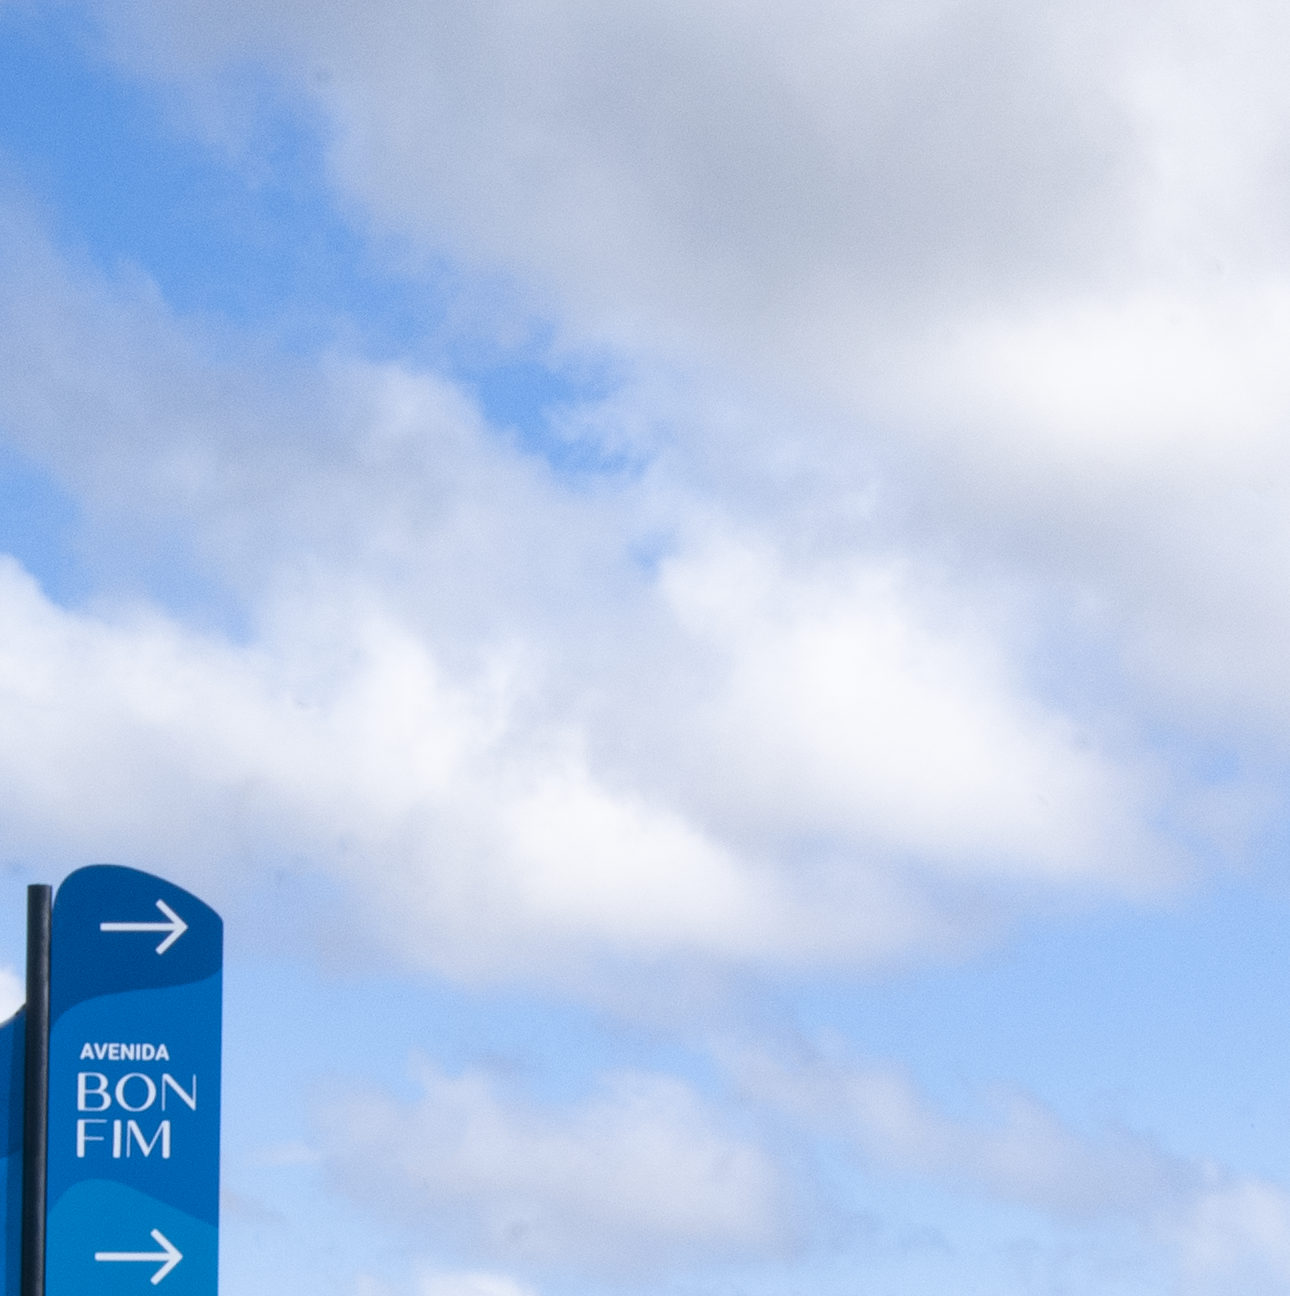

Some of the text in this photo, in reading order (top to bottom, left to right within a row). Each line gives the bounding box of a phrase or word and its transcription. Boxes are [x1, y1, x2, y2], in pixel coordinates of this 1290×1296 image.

[80, 1042, 170, 1061] AVENIDA
[76, 1071, 197, 1112] BON
[76, 1118, 171, 1159] FIM
